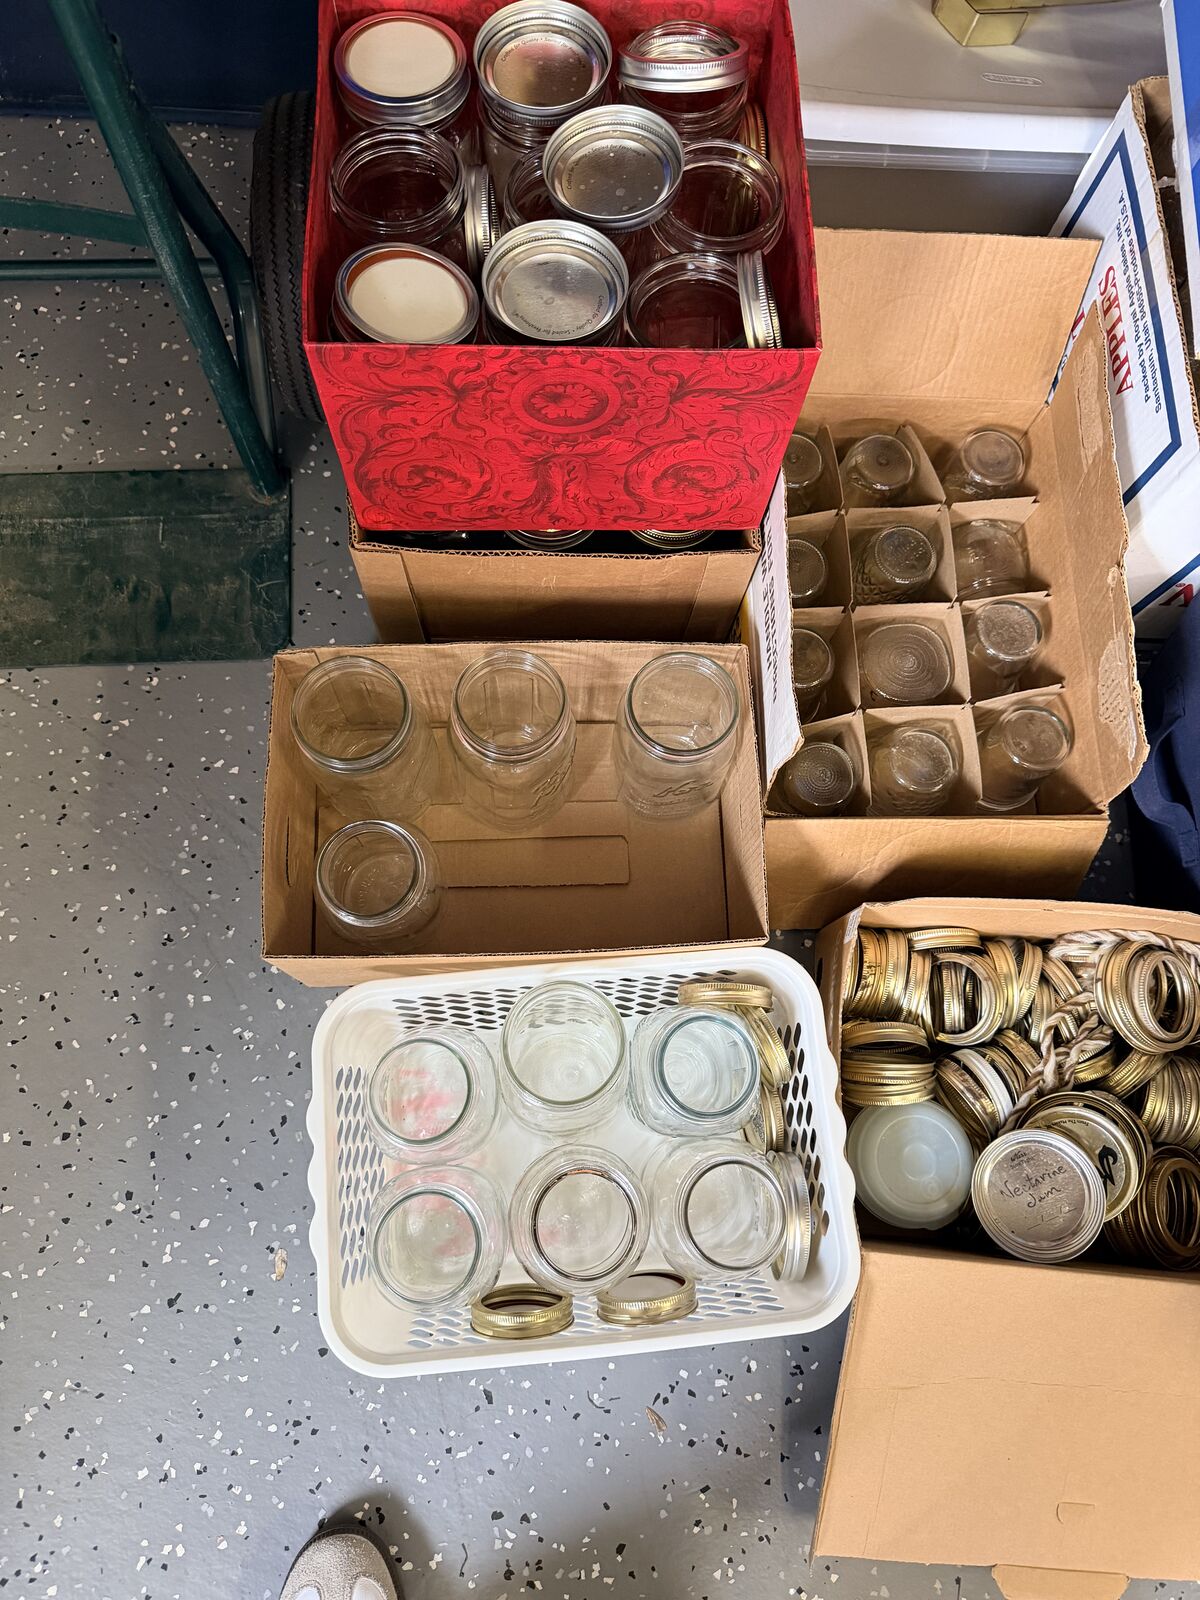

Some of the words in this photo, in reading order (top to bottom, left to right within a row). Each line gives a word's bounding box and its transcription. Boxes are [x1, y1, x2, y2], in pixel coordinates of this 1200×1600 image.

[1118, 189, 1129, 226] U.S.A.
[1124, 224, 1132, 238] of
[1120, 239, 1130, 276] Sales,
[1126, 275, 1135, 308] Apple
[1098, 266, 1133, 395] APPLES
[1131, 308, 1141, 343] Royal
[1142, 320, 1152, 351] Utah
[1137, 342, 1144, 360] by
[1139, 360, 1151, 403] Packed
[1148, 348, 1162, 413] Santaquin,
[763, 582, 772, 672] HANDLE
[769, 575, 778, 704] DIRECTIONS
[1000, 1165, 1067, 1198] Nectarine
